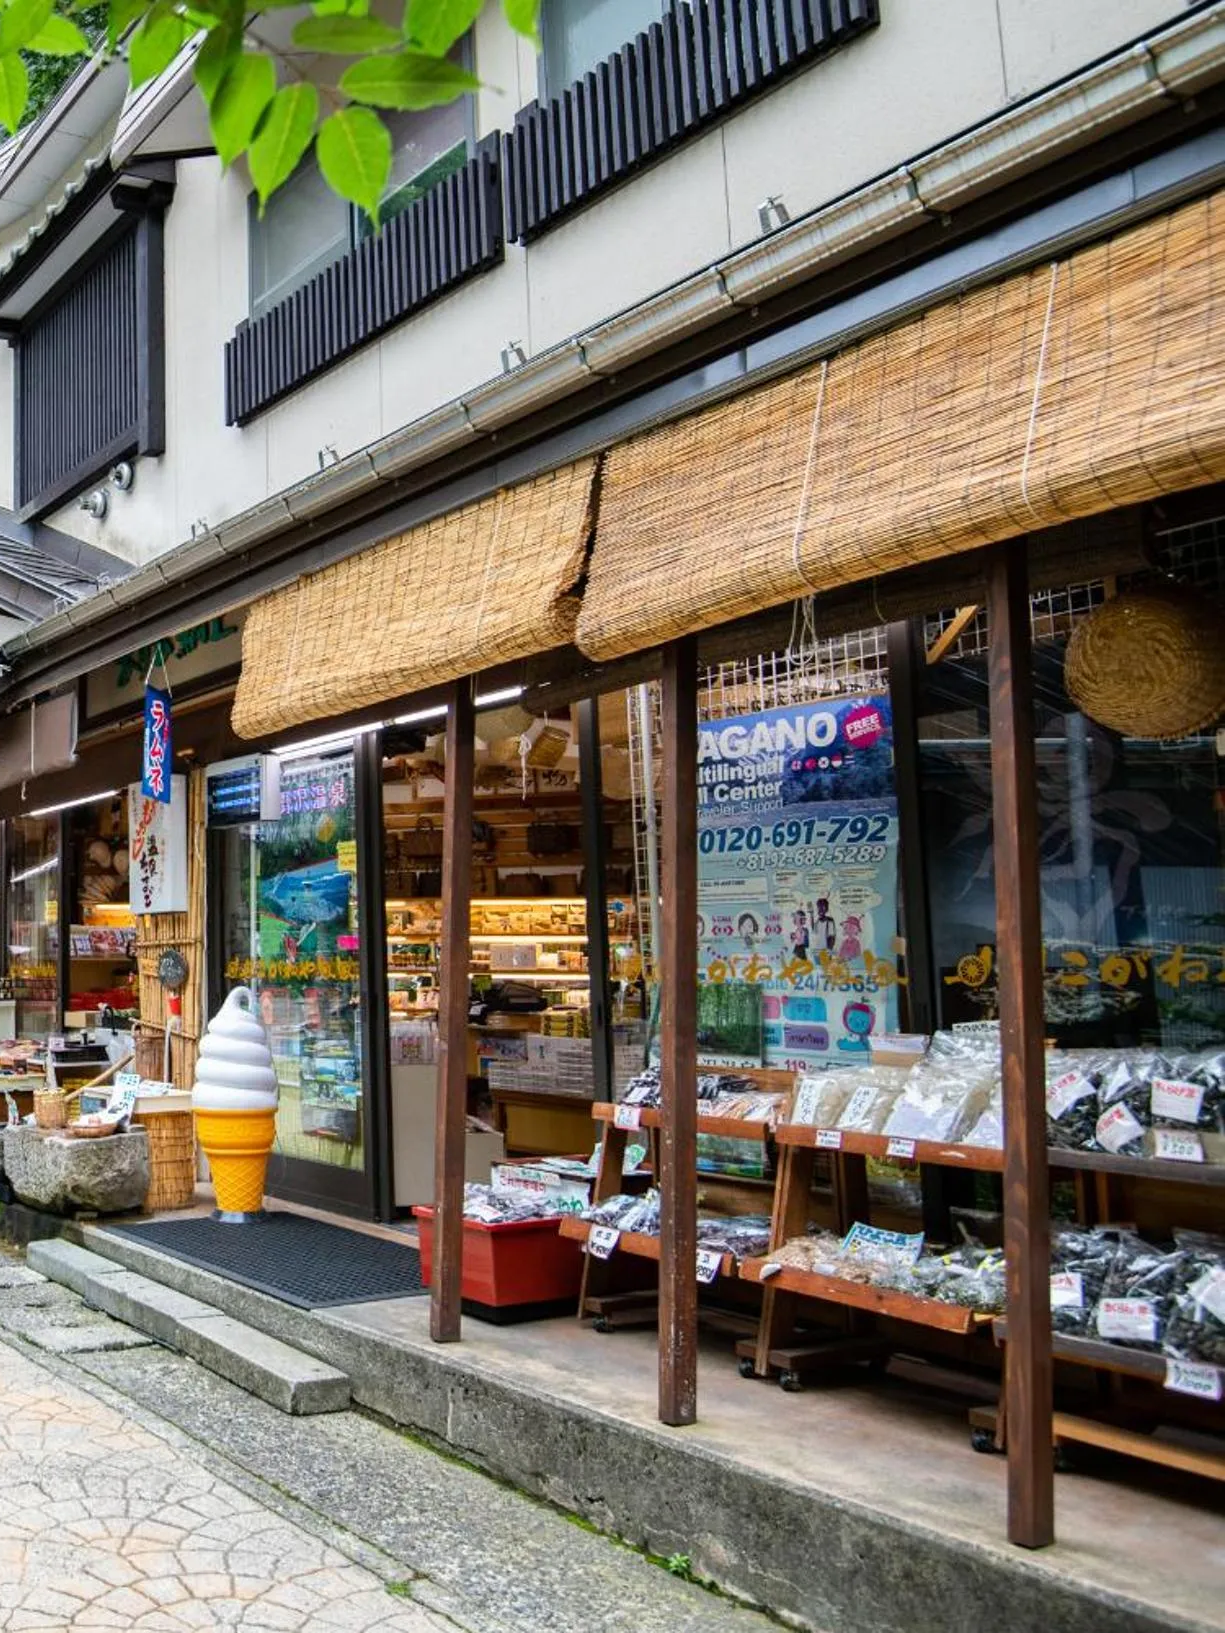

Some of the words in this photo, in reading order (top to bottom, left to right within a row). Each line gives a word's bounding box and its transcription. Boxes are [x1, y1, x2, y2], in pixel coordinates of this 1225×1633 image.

[698, 711, 838, 762] AGANO
[845, 714, 880, 734] FREE
[149, 699, 165, 797] ラムネ
[714, 780, 783, 802] Center
[699, 815, 891, 854] 0120-691-792
[1060, 945, 1225, 988] こがね
